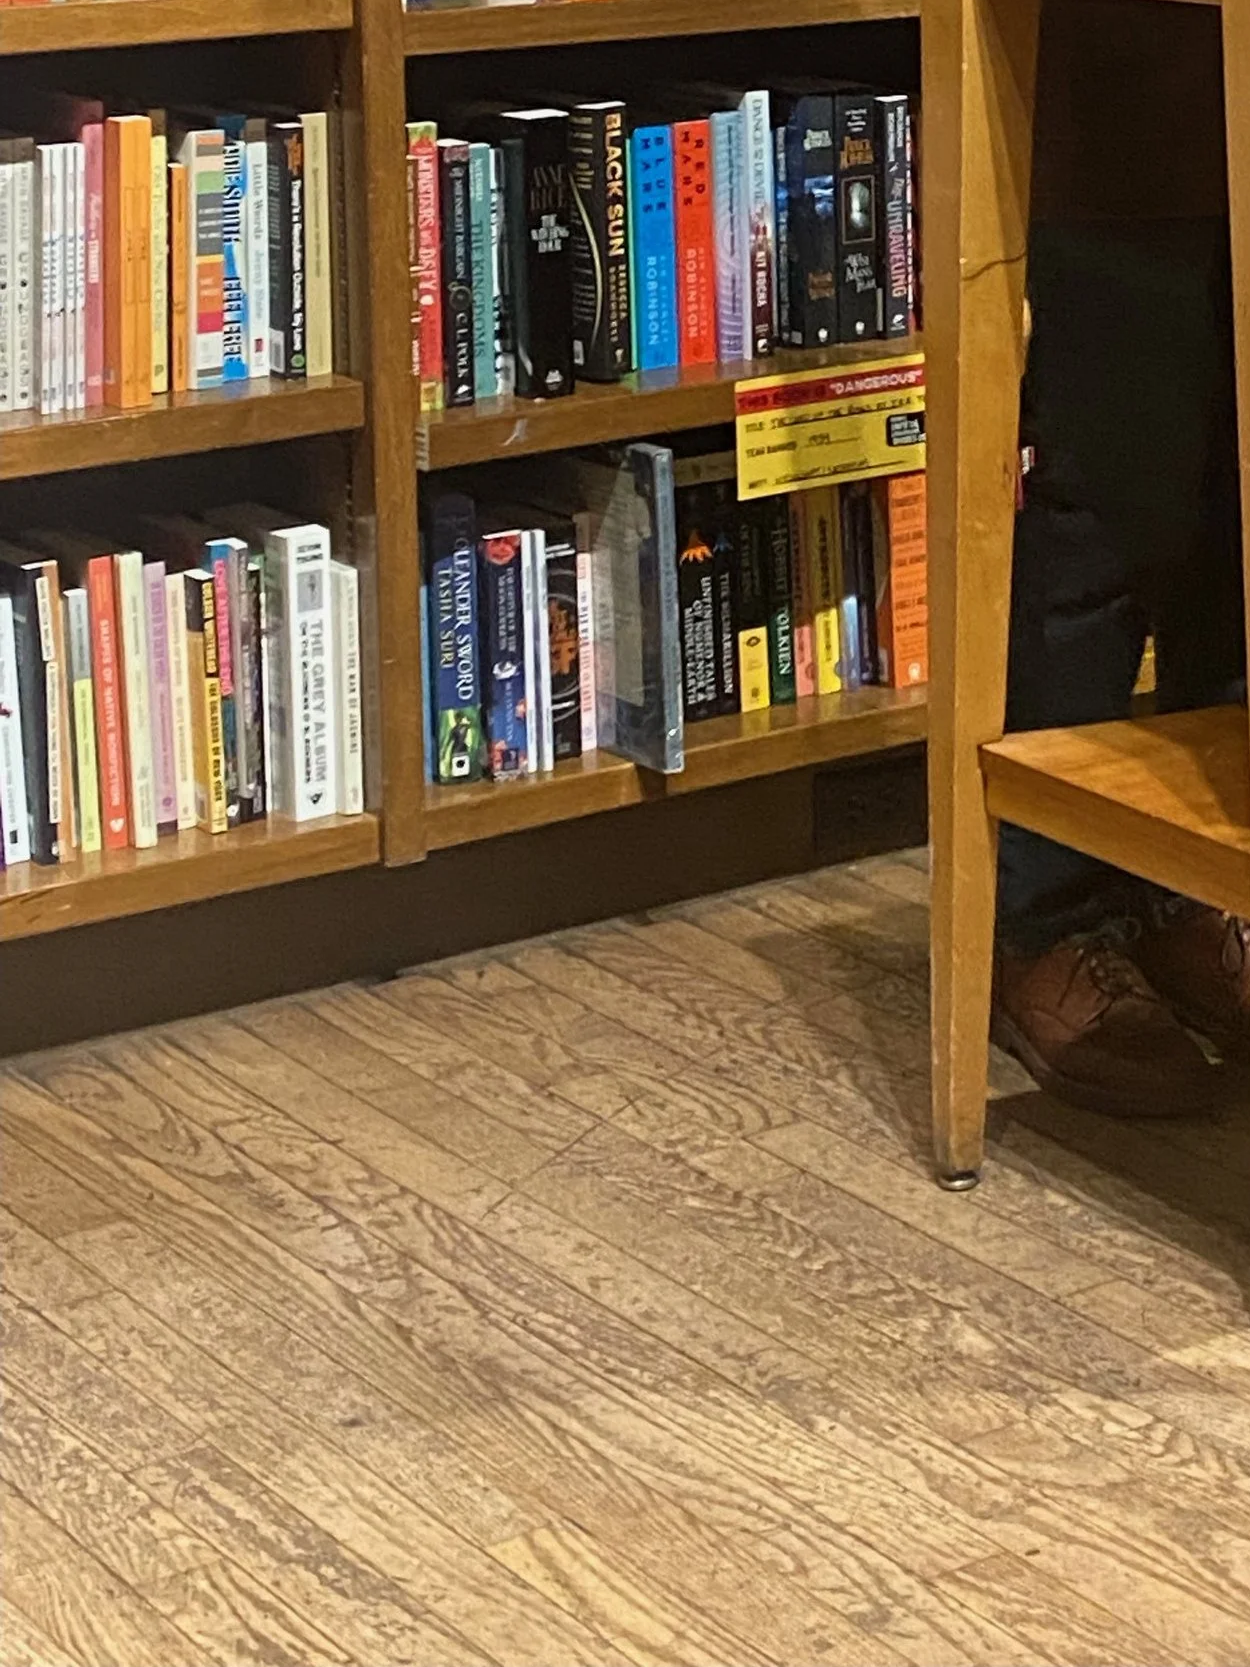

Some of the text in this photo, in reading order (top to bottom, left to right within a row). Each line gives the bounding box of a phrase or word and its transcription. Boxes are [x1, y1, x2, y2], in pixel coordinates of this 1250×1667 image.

[752, 98, 765, 146] DANCE
[416, 155, 436, 228] MONSTERS
[604, 112, 626, 257] BLACK SUN
[641, 137, 653, 214] MARS
[654, 136, 667, 212] BLUE
[681, 130, 693, 206] MARS
[694, 137, 707, 195] RED
[252, 163, 266, 320] Little Weirds Jenny Slate
[886, 200, 908, 298] UNRAVELING
[471, 219, 486, 358] THE KINGDOMS
[645, 255, 661, 346] ROBINSON
[685, 246, 699, 339] ROBINSON
[456, 342, 470, 379] POLK
[830, 369, 923, 395] "DANGEROUS"
[438, 566, 456, 670] TASHA SURI
[453, 537, 475, 701] OLEANDER SWORD
[720, 601, 734, 694] SILMARILLION
[776, 604, 792, 676] TOLKIEN
[104, 686, 116, 731] NATIVE
[310, 619, 328, 783] THE GREY ALBUM
